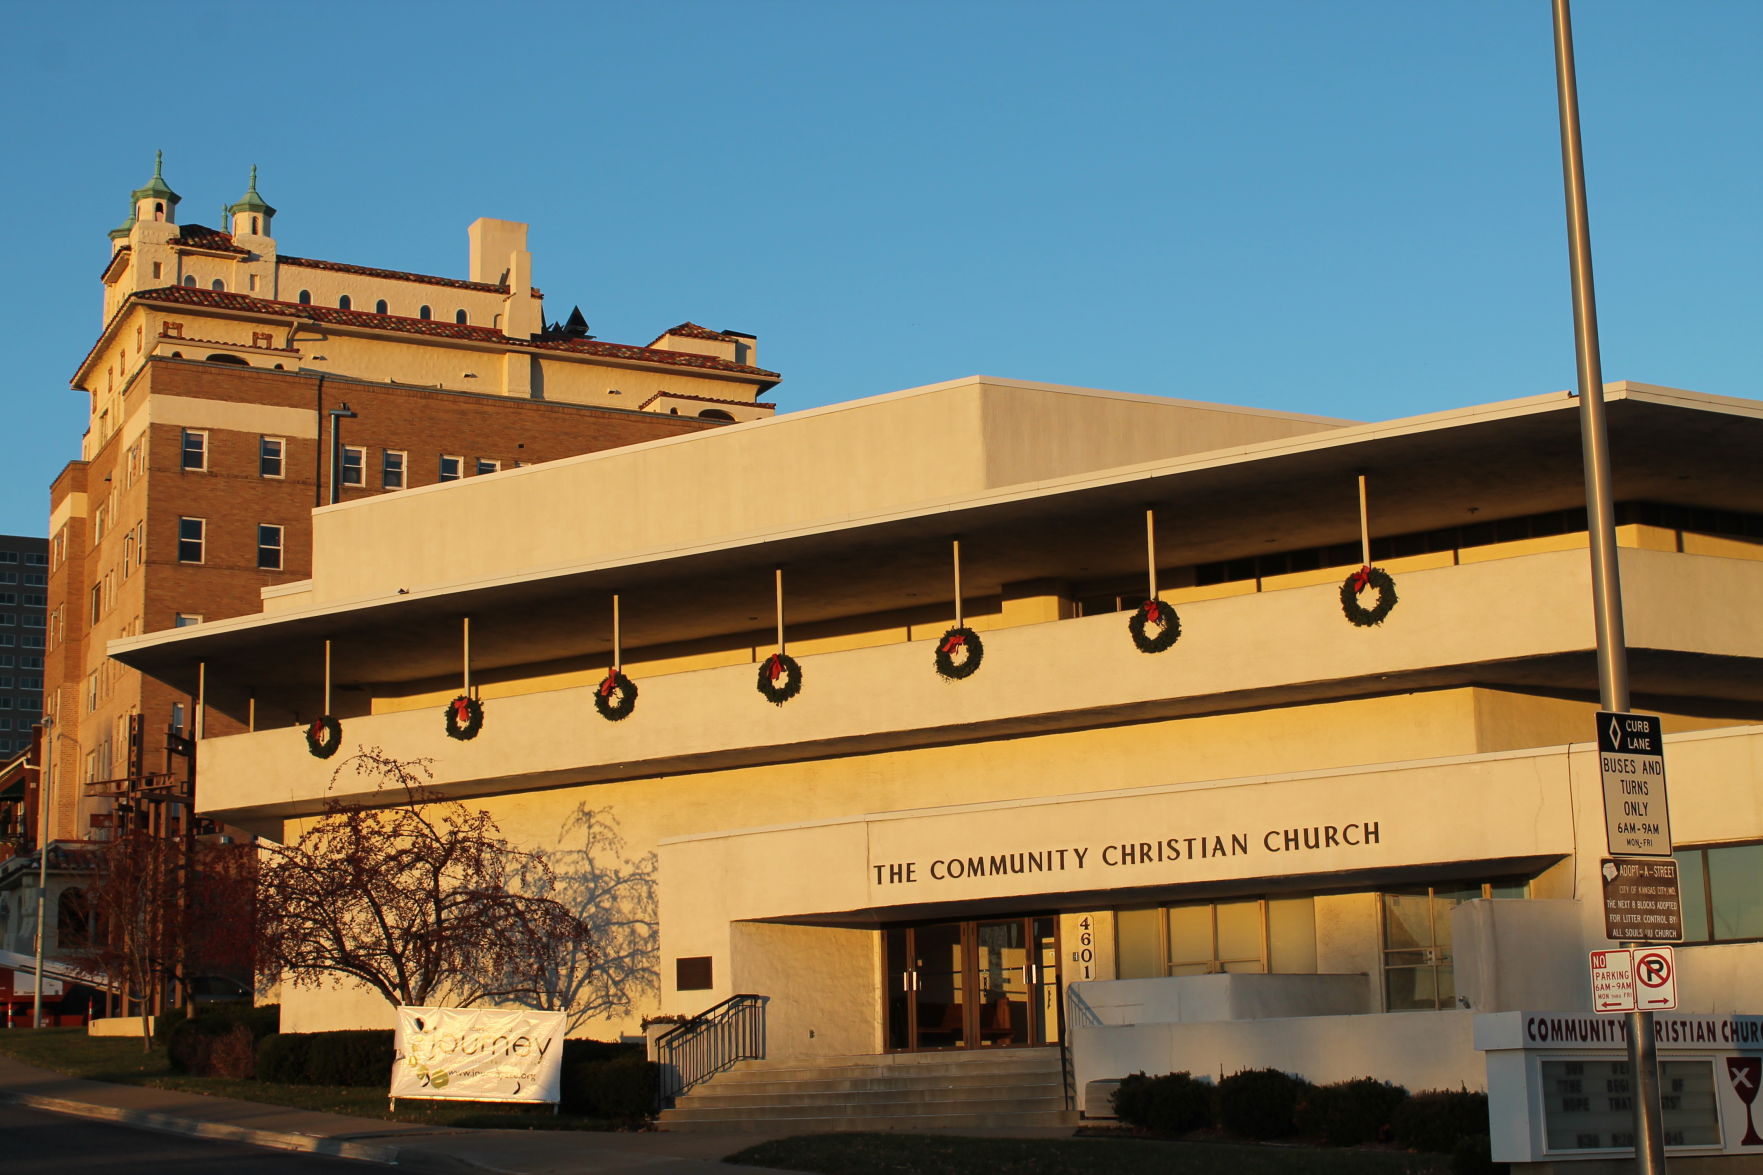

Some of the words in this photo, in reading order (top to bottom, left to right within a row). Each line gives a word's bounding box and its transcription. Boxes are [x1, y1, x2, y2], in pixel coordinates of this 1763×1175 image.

[1625, 720, 1650, 732] CURB
[1627, 738, 1651, 750] LANE
[1603, 758, 1636, 774] BUSES
[1642, 760, 1661, 775] AND
[1620, 780, 1649, 795] TURNS
[1624, 801, 1648, 816] ONLY
[873, 862, 918, 885] THE
[930, 847, 1089, 880] COMMUNITY
[1102, 833, 1248, 866] CHRISTIAN
[1263, 821, 1380, 853] CHURCH
[1619, 864, 1675, 878] ADOPT-A-STREET
[1619, 886, 1630, 894] CITY
[1631, 886, 1637, 895] OF
[1638, 887, 1656, 895] KANSAS
[1607, 900, 1616, 909] THE
[1618, 901, 1631, 910] NEXT
[1637, 901, 1656, 910] BLOCKS
[1657, 901, 1677, 911] ADOPTED
[1610, 913, 1620, 923] FOR
[1623, 914, 1641, 923] LITTER
[1643, 914, 1668, 924] CONTROL
[1612, 928, 1623, 937] ALL
[1625, 928, 1643, 938] SOULS
[1655, 929, 1677, 938] CHURCH
[1080, 916, 1093, 979] 4601
[1592, 955, 1606, 968] NO
[1595, 970, 1629, 981] PARKING
[1527, 1017, 1627, 1042] COMMUNITY
[1654, 1020, 1717, 1042] RISTIAN
[1721, 1019, 1763, 1042] CHUR
